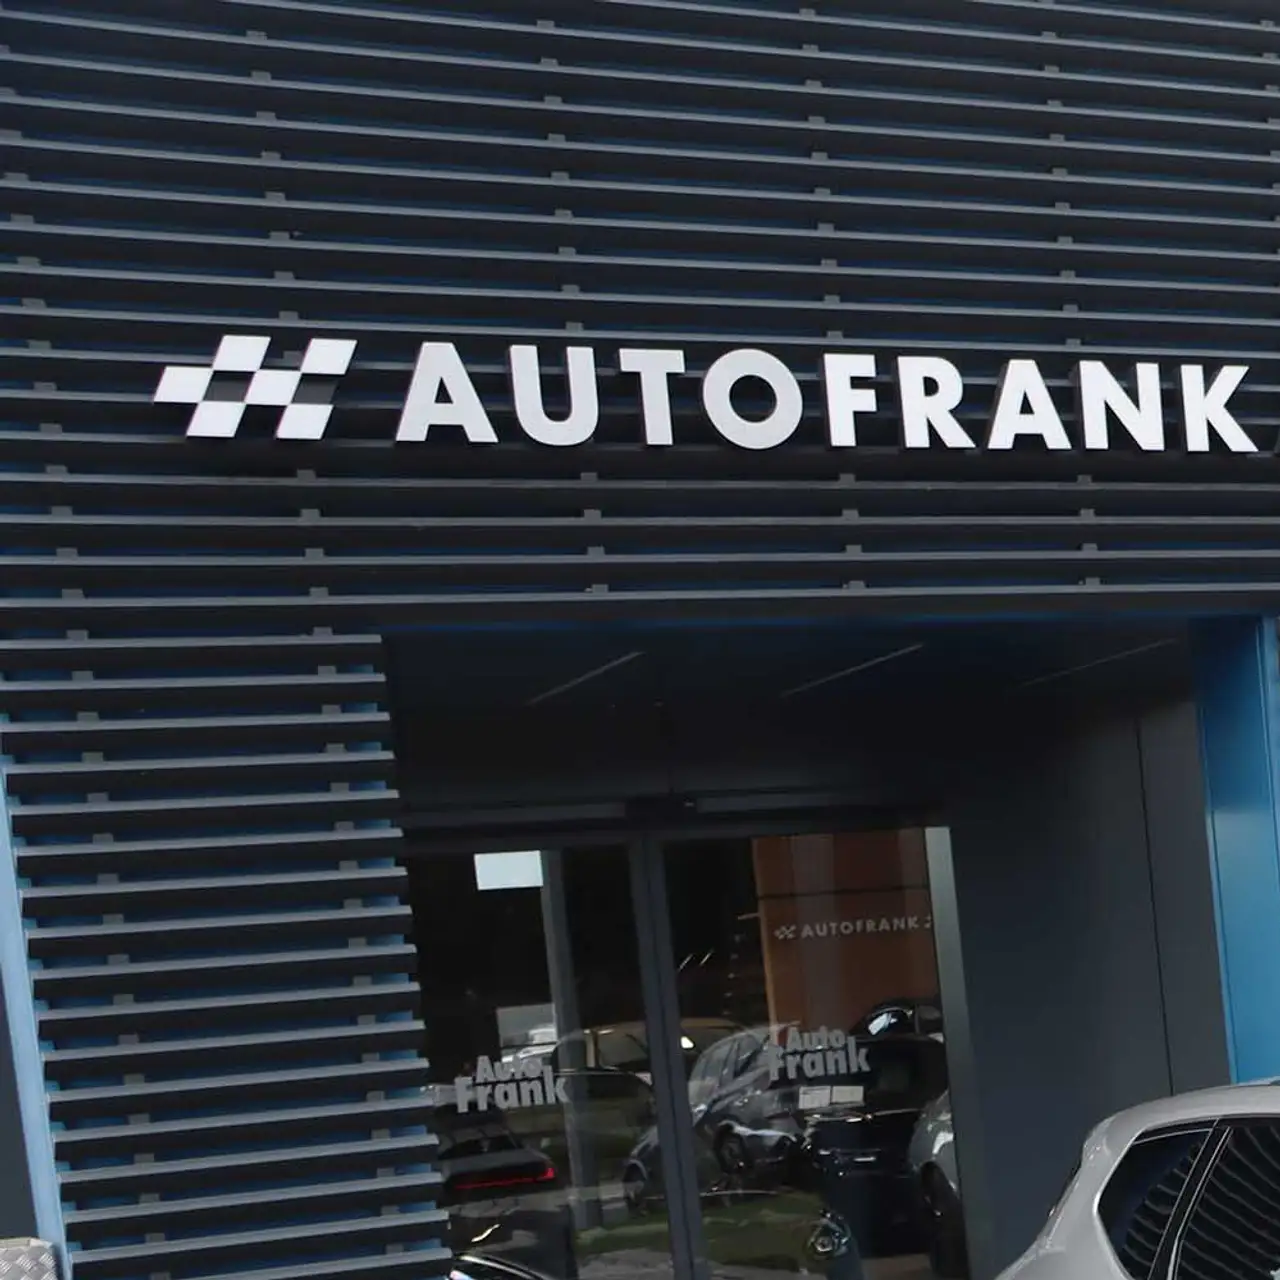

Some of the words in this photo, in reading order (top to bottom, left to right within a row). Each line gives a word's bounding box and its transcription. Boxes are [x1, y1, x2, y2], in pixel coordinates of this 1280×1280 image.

[397, 341, 1259, 453] AUTOFRANK
[800, 915, 920, 938] AUTOFRANK
[475, 1055, 543, 1083] Auto
[767, 1035, 871, 1081] Frank
[454, 1065, 570, 1114] Frank
